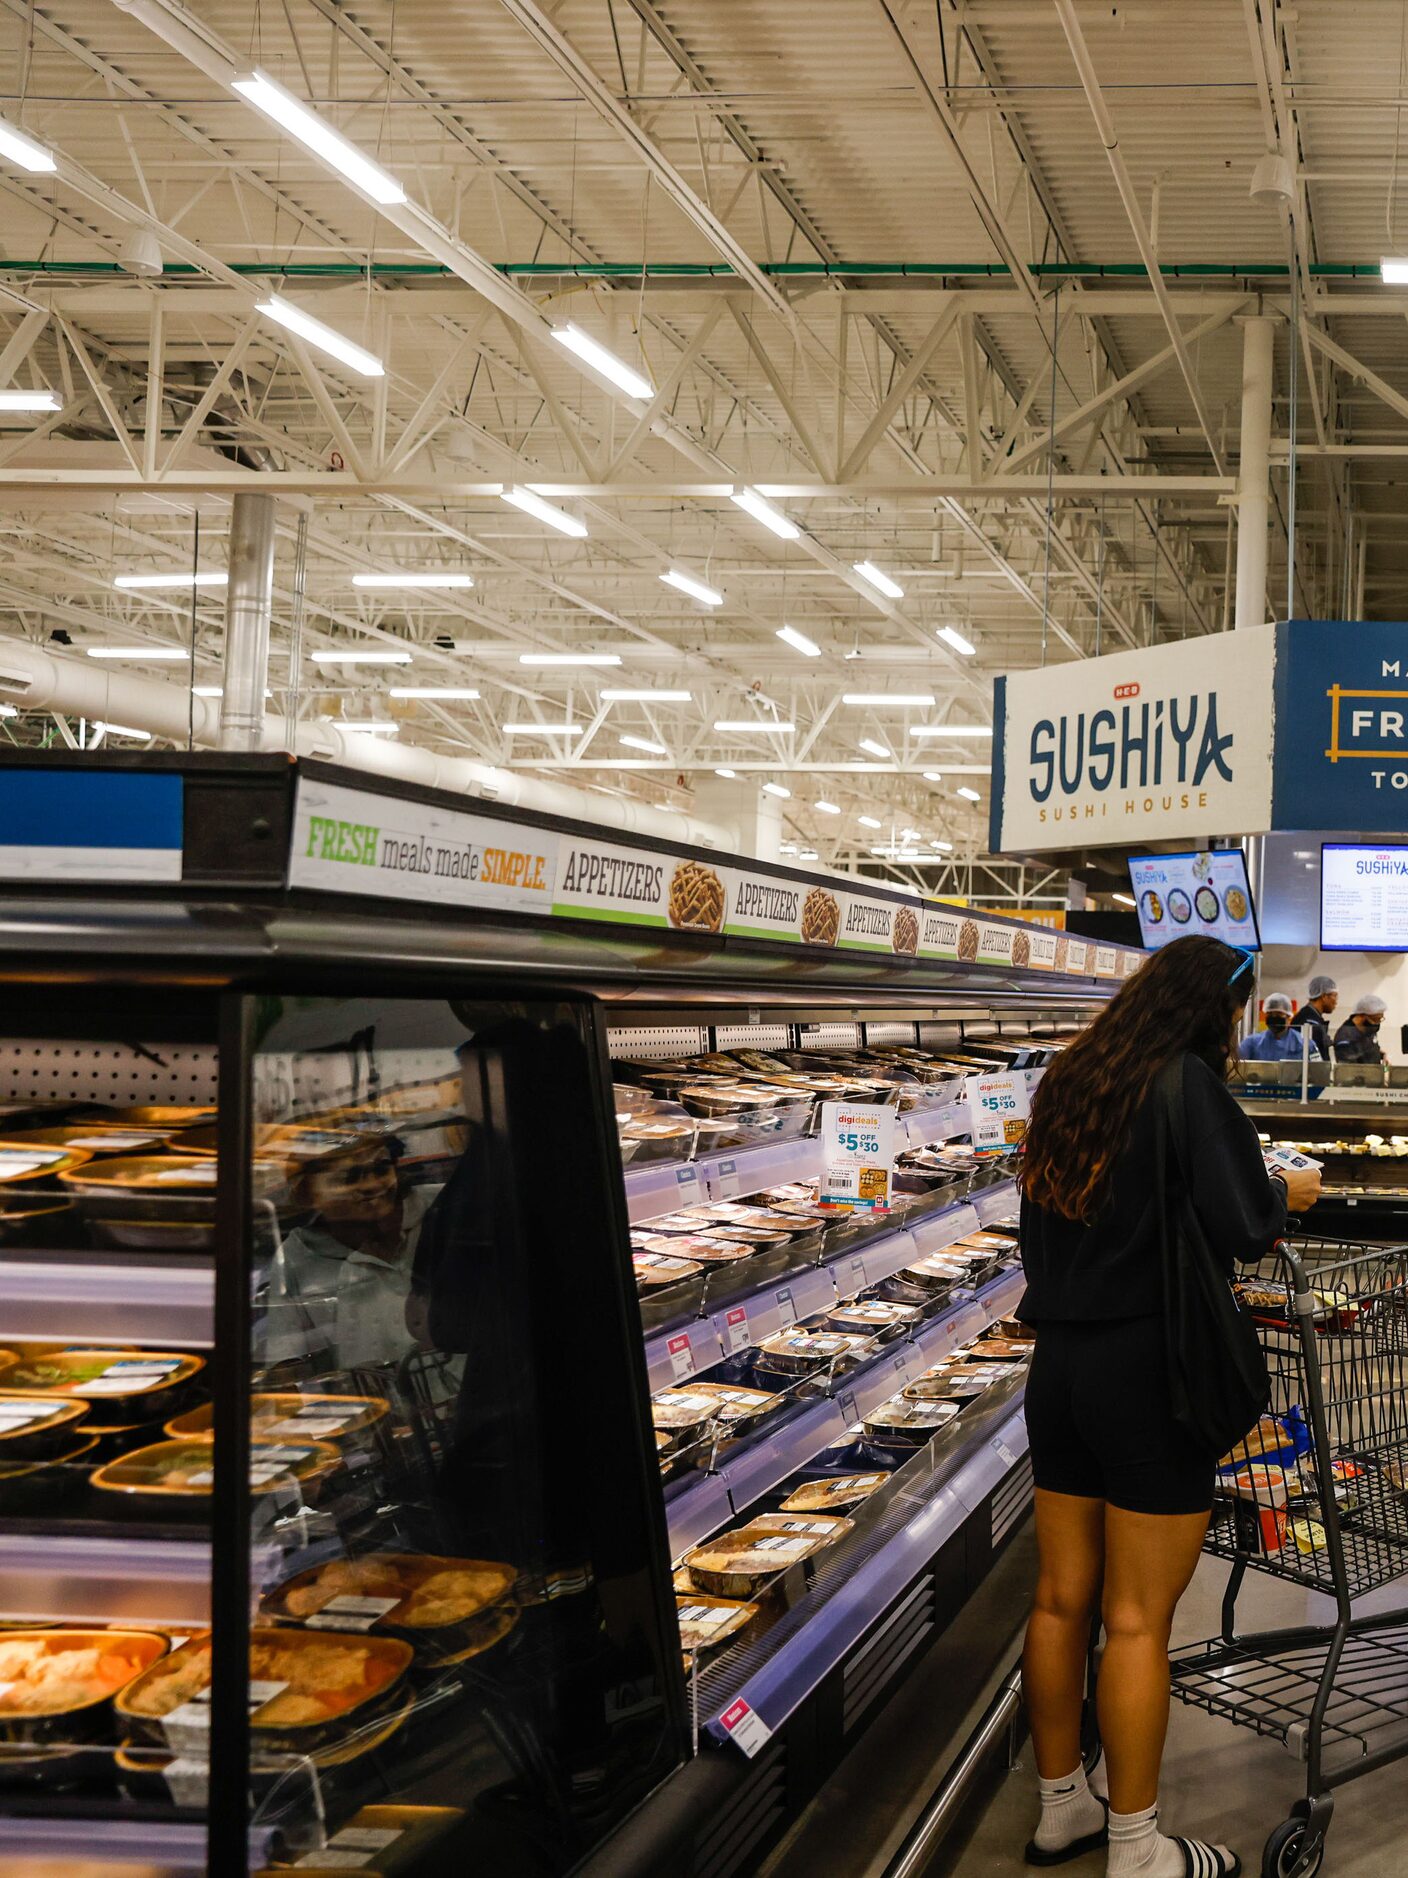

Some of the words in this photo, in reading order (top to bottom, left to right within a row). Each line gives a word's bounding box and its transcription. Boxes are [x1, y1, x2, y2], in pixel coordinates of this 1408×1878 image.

[1039, 802, 1108, 823] SUSHI
[1125, 791, 1209, 815] HOUSE
[305, 815, 380, 866] FRESH
[380, 835, 433, 877] meals
[434, 844, 479, 882] made
[563, 850, 664, 904] APPETIZERS
[735, 881, 799, 923] APPETIZERS
[846, 903, 892, 937] APPETIZERS
[923, 918, 958, 947] APPETIZERS
[981, 929, 1011, 954] APPETIZERS
[979, 1082, 1013, 1092] digideals
[982, 1097, 999, 1111] $5
[1000, 1101, 1016, 1109] $30
[838, 1115, 878, 1125] digideals
[838, 1133, 858, 1151] $5
[859, 1141, 879, 1152] $30
